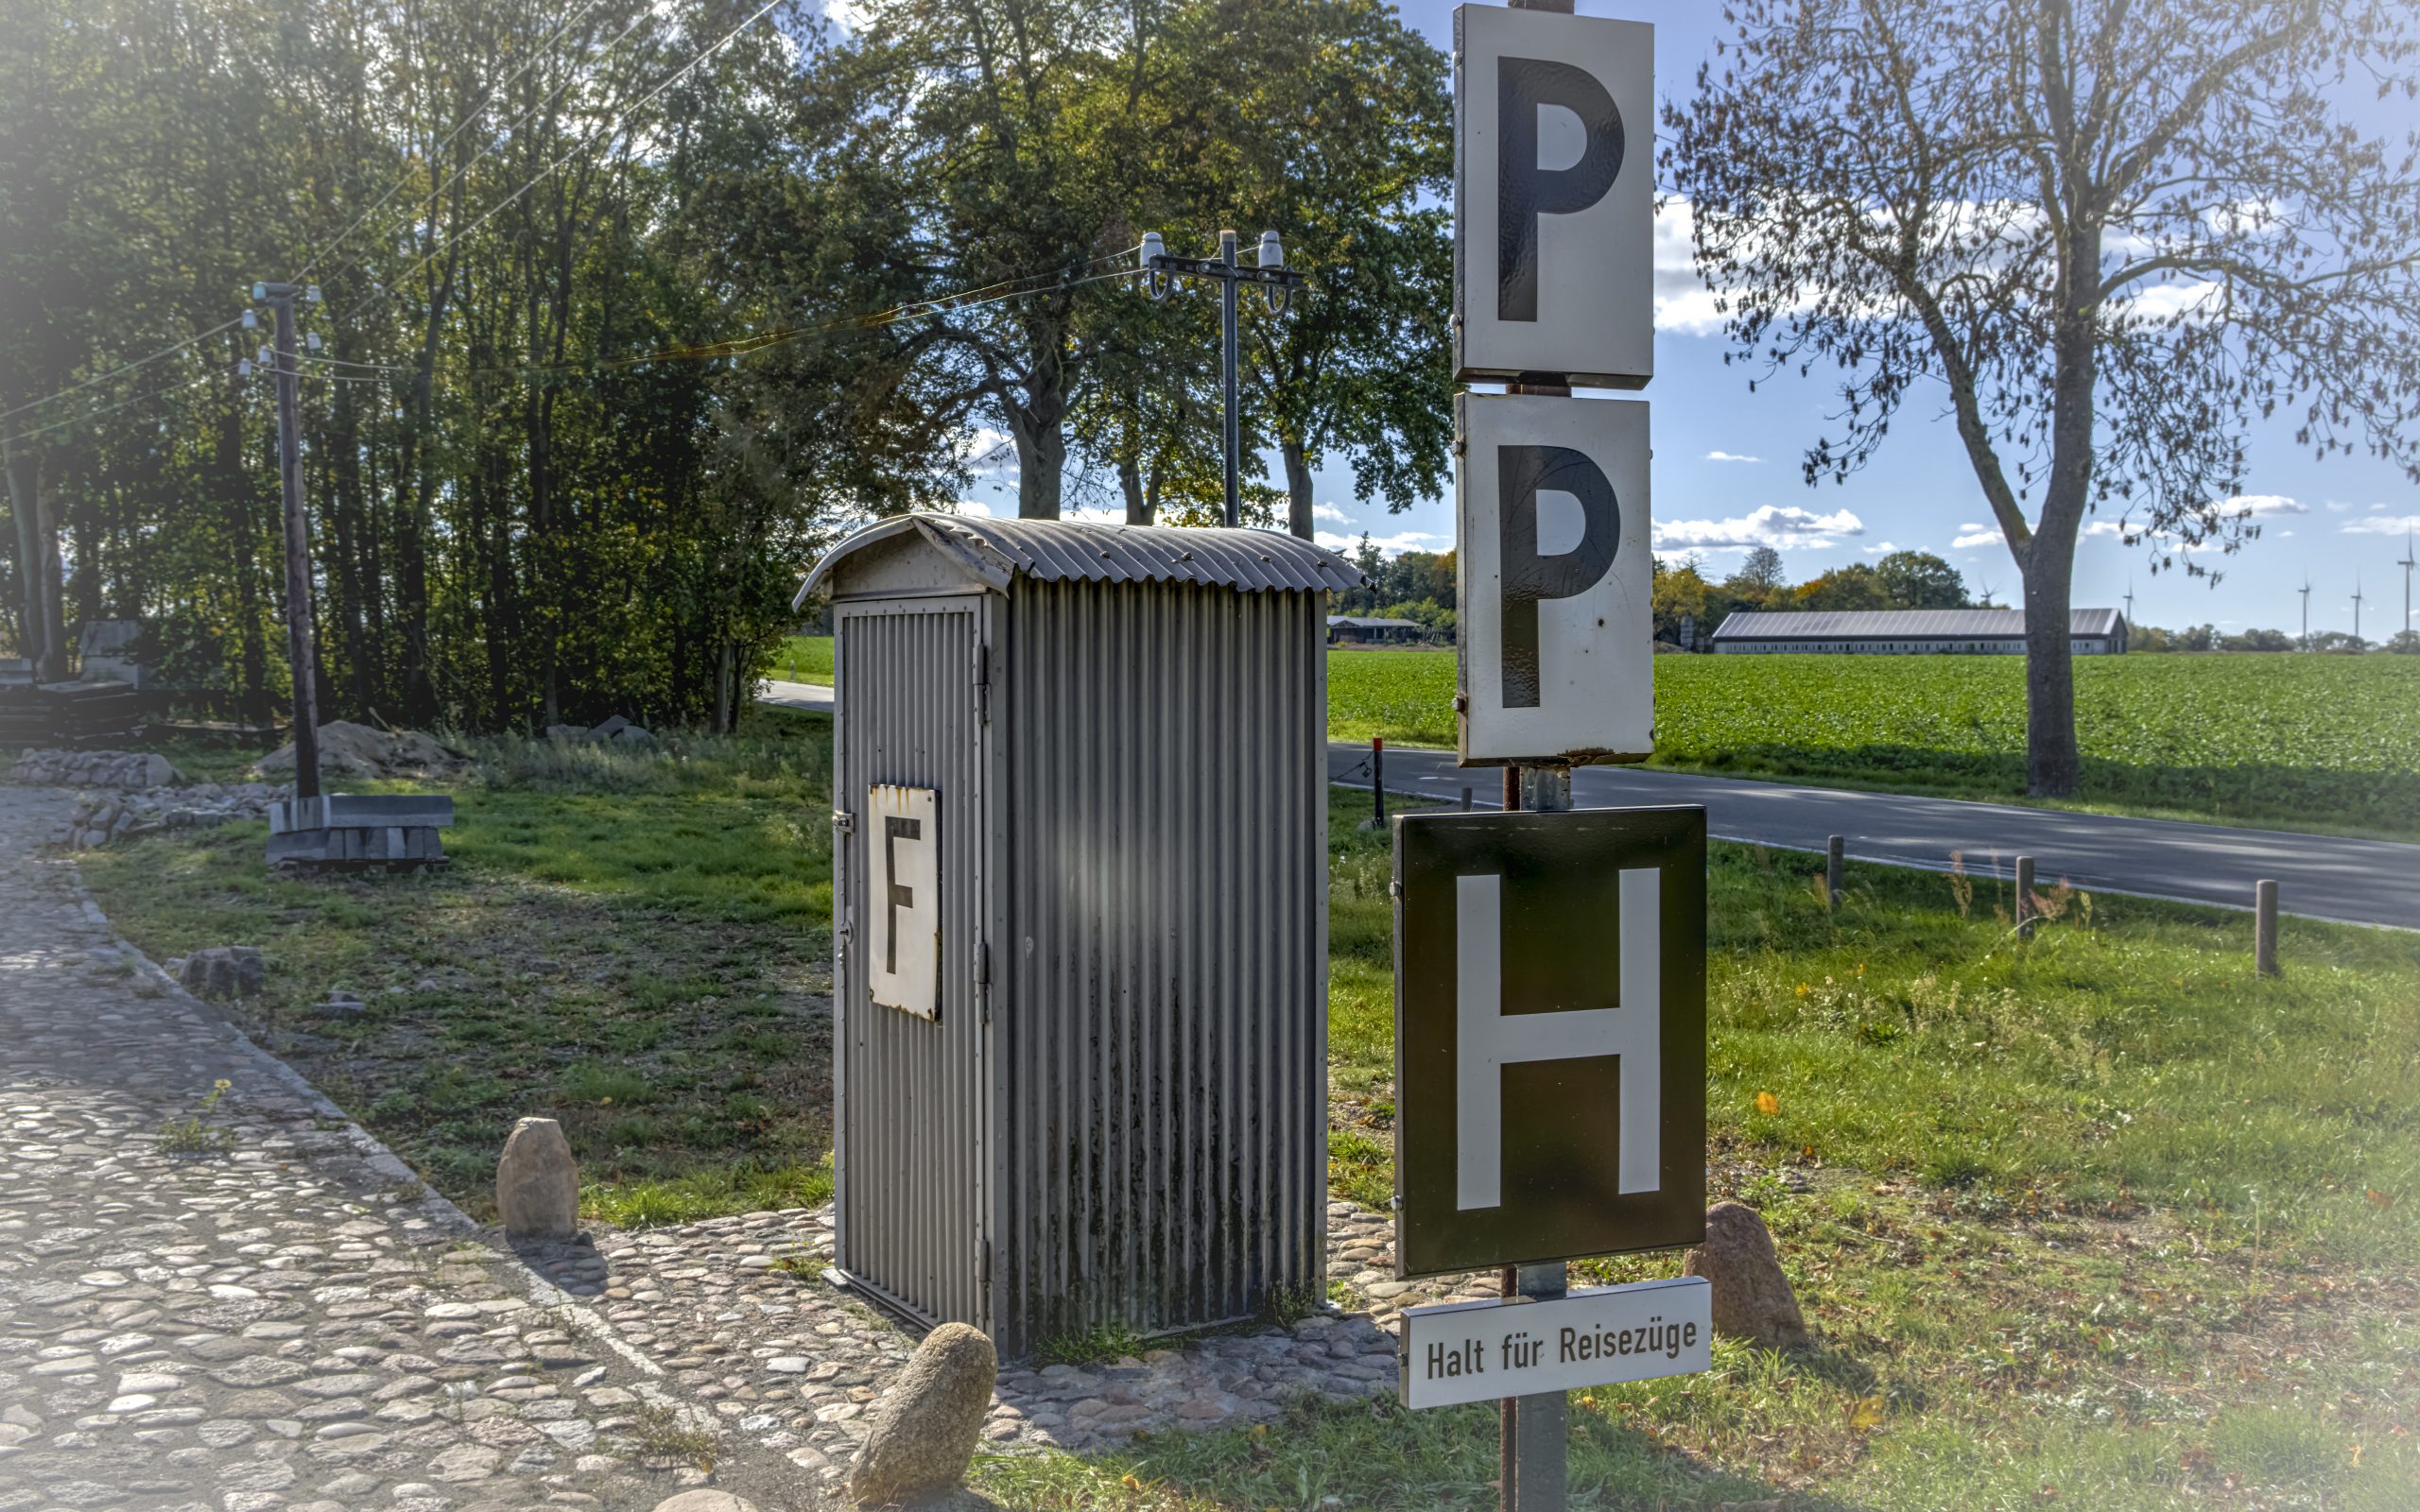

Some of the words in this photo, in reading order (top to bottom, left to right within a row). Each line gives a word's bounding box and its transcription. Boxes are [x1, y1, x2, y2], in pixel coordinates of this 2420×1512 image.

[1497, 56, 1625, 321] P
[1497, 445, 1620, 709] P
[885, 816, 921, 974] F
[1456, 868, 1660, 1211] H
[1427, 1339, 1484, 1379] Halt
[1501, 1332, 1544, 1370] für
[1560, 1316, 1697, 1363] Reisezüge
